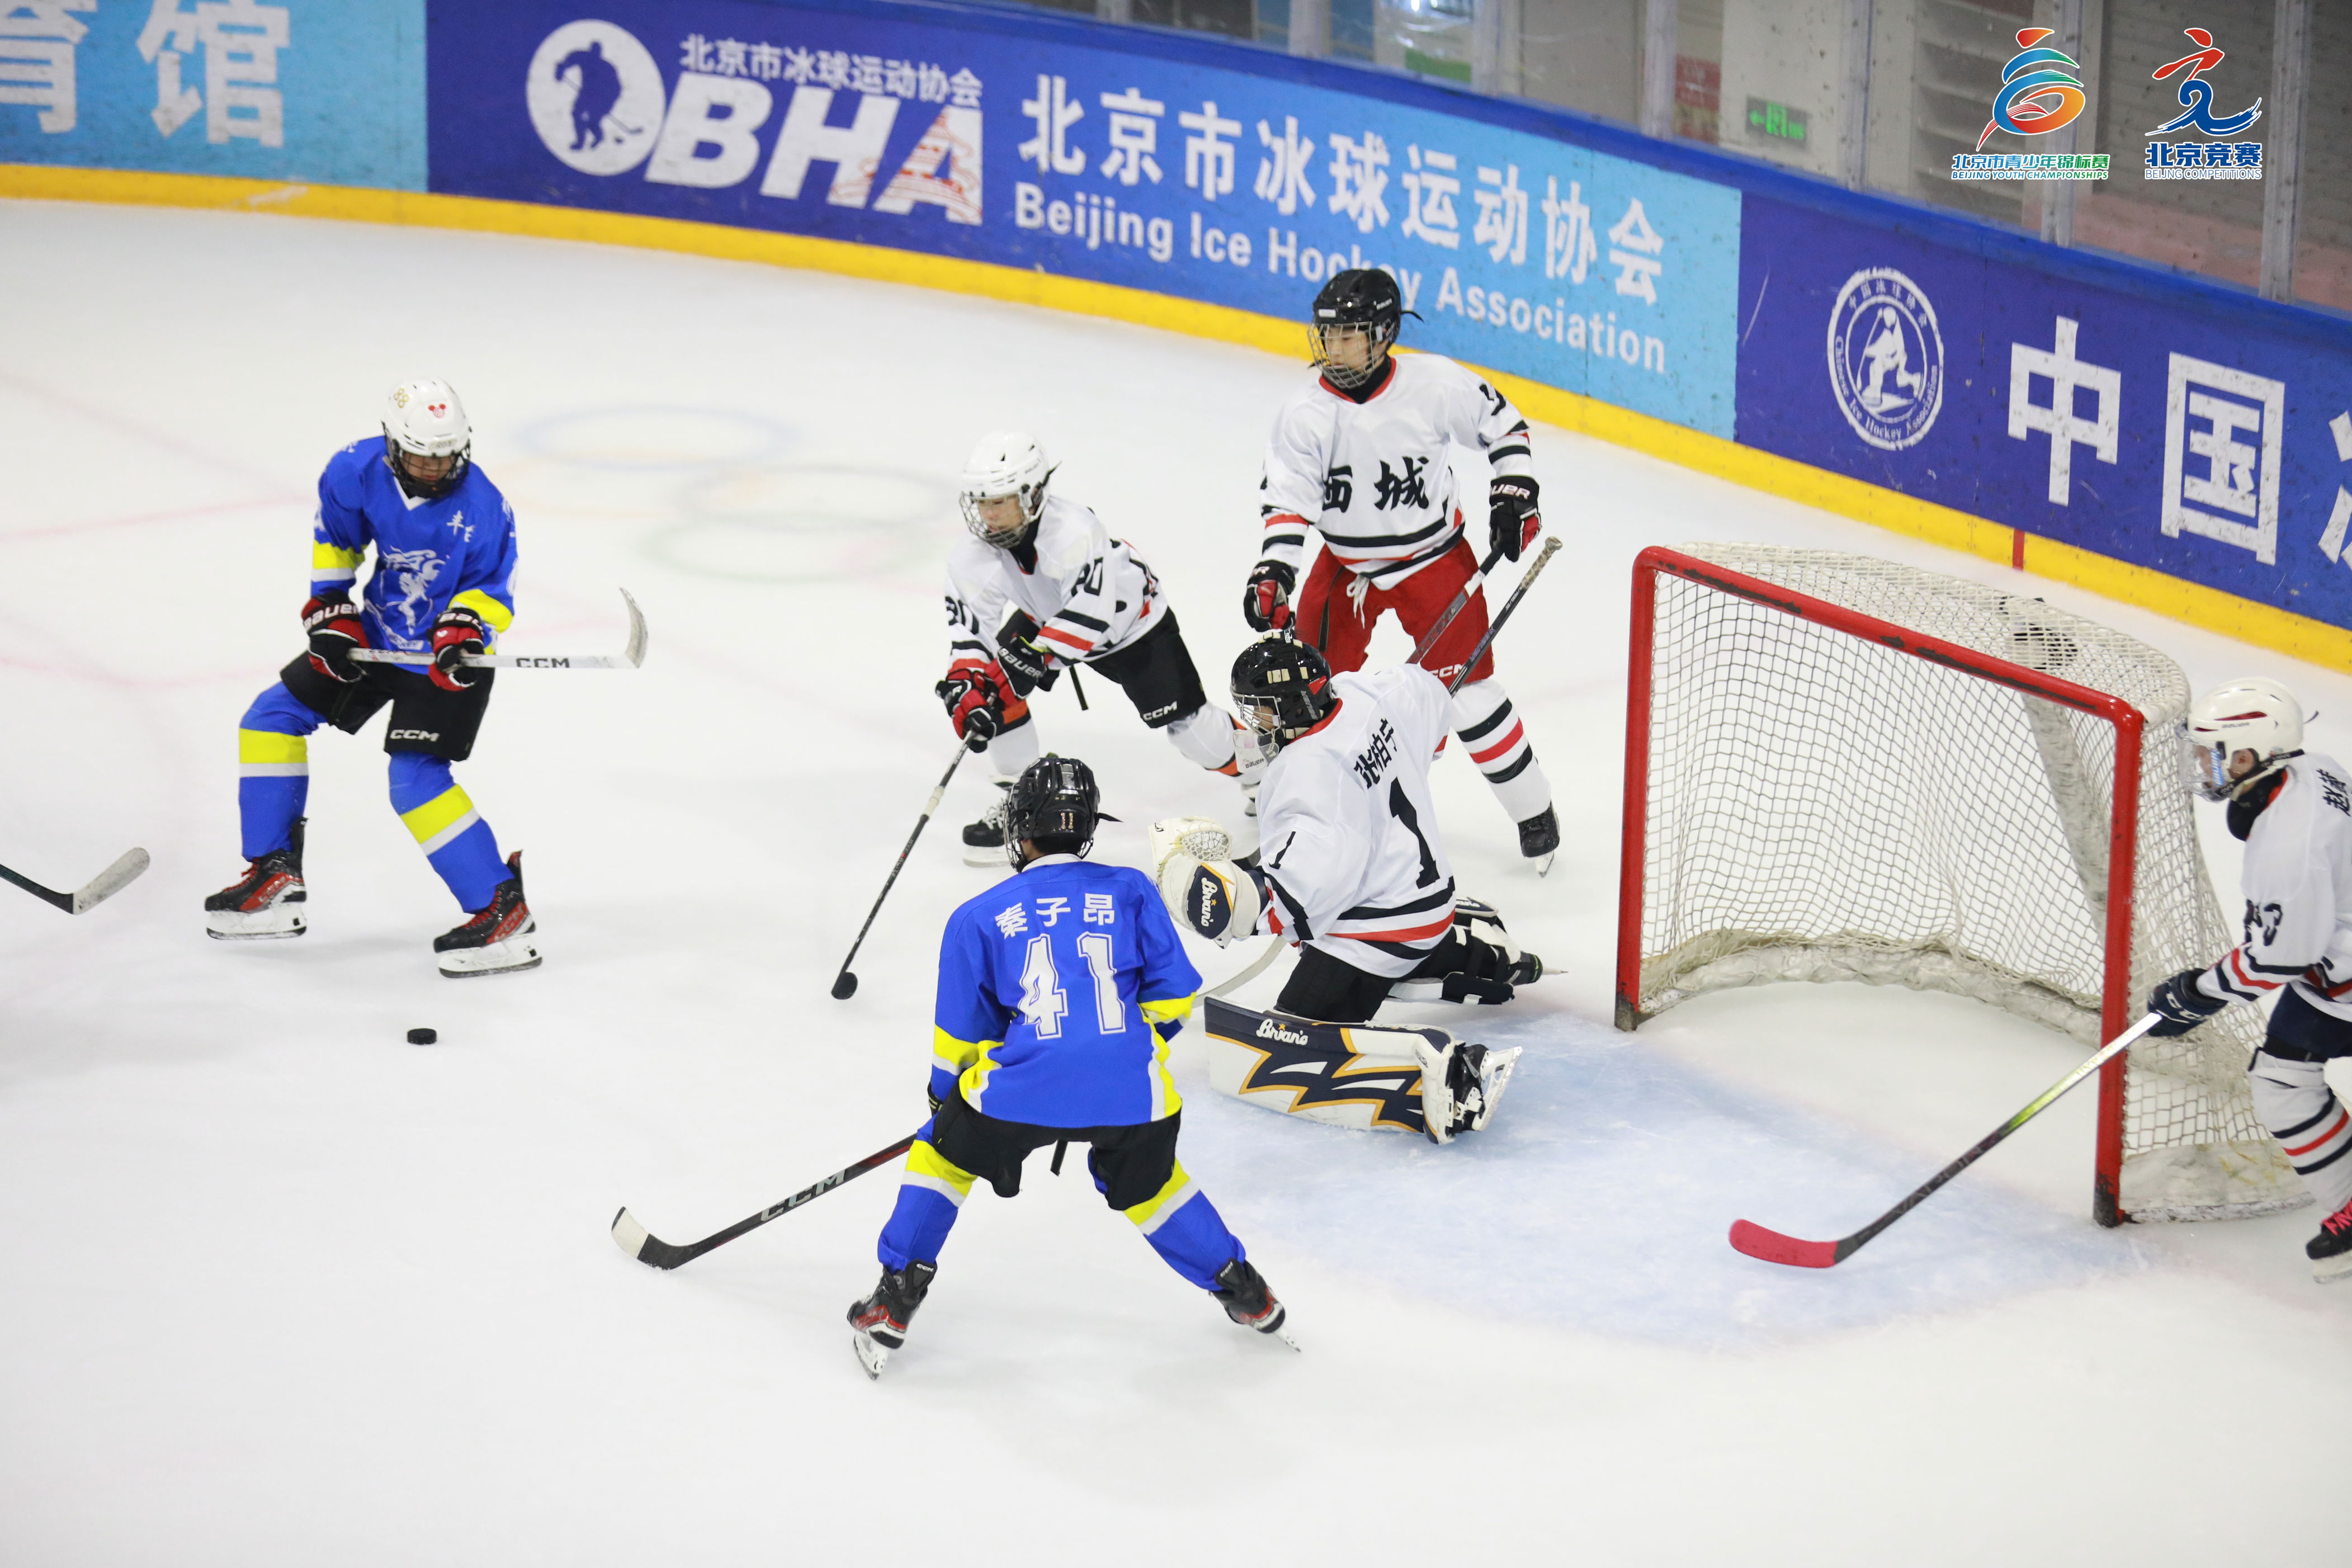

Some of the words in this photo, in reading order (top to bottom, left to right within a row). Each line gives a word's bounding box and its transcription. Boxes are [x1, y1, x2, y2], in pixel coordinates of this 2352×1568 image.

[679, 34, 983, 108] 北京市冰球运动协会
[1017, 74, 1664, 306] 北京市冰球运动协会
[1015, 182, 1173, 263] Beijing
[1190, 212, 1253, 267] Ice
[1436, 267, 1665, 374] Association
[393, 388, 410, 408] 88
[1835, 335, 1850, 398] Chinese
[1849, 396, 1863, 421] Ice
[1864, 416, 1902, 440] Hockey
[1905, 365, 1938, 437] Association
[1322, 455, 1430, 514] 西城
[515, 657, 570, 669] CCM
[1142, 700, 1178, 722] CCM
[390, 728, 440, 743] CCM
[1245, 758, 1265, 769] BAUER
[1060, 812, 1074, 830] 11
[1388, 776, 1441, 890] 1
[1269, 830, 1296, 870] 1
[995, 892, 1116, 939] 秦子昂
[1017, 931, 1126, 1041] 41
[1256, 1018, 1309, 1046] Brian's
[761, 1169, 846, 1222] CCM
